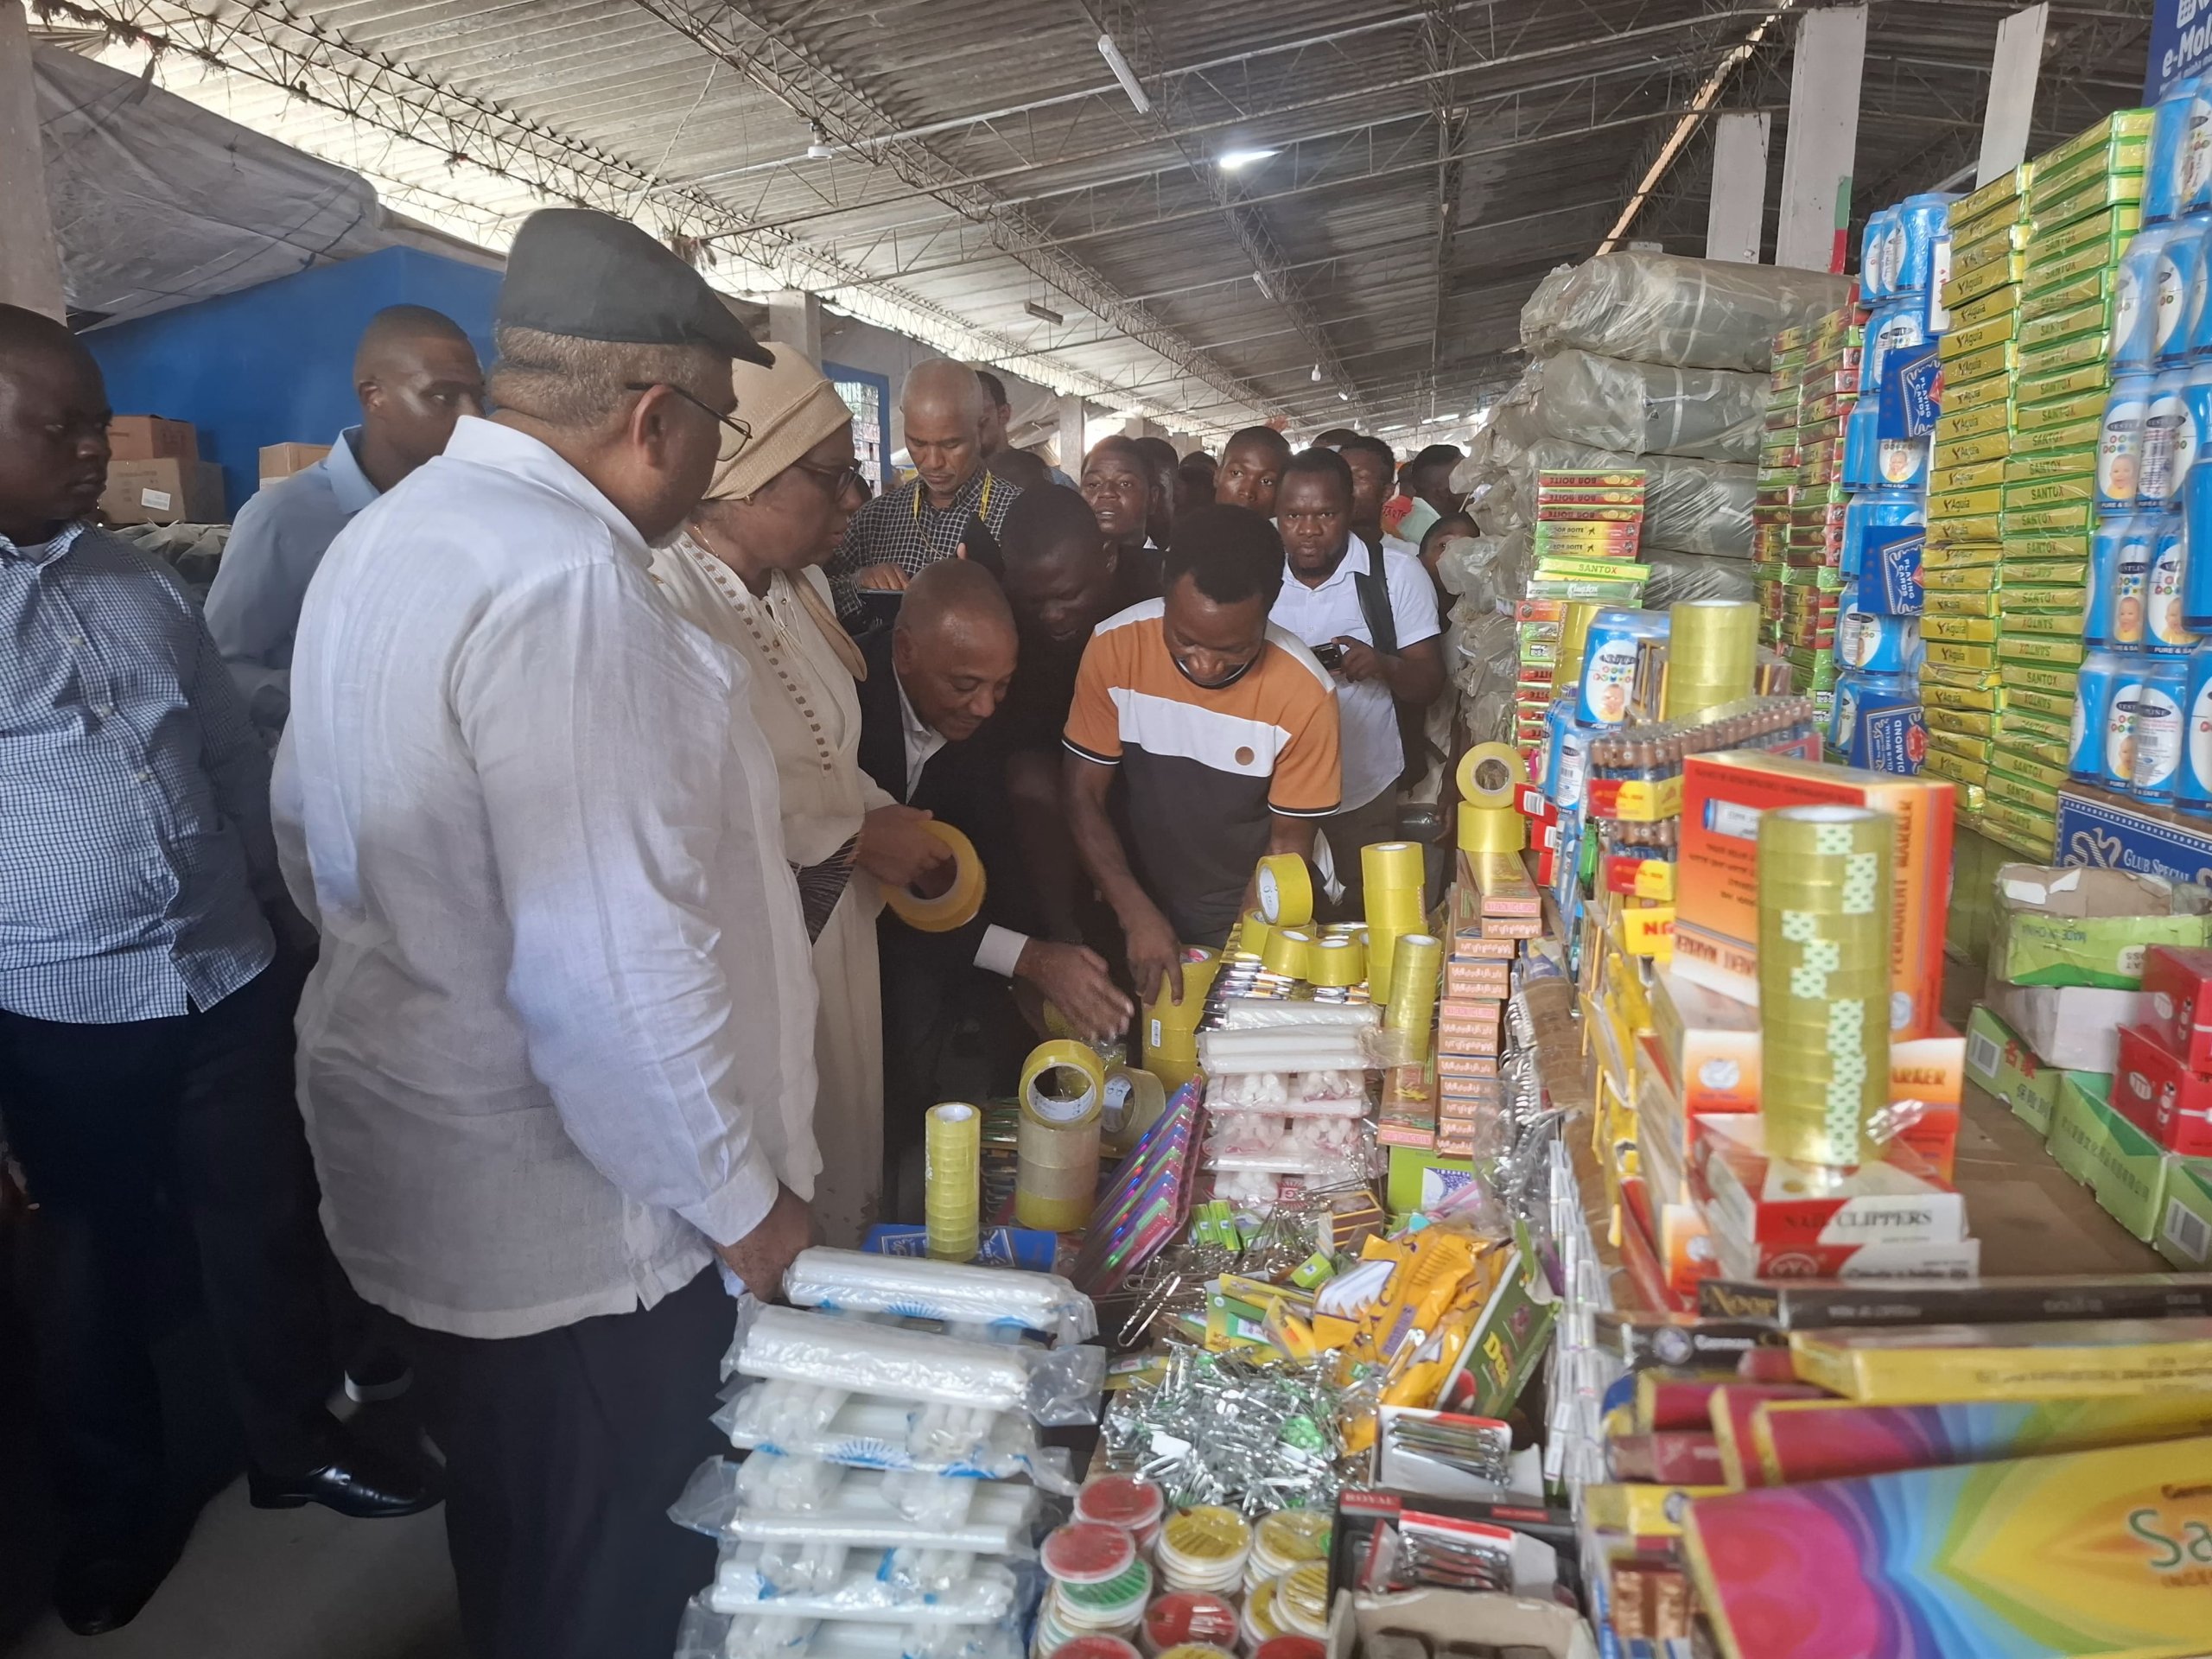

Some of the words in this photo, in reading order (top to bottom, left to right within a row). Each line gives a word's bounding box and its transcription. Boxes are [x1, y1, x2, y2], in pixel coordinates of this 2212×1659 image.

[1916, 384, 1925, 416] CARDS
[1920, 376, 1931, 418] PLAYING
[2031, 485, 2064, 500] SANTOX
[1579, 563, 1618, 575] SANTOX
[1898, 565, 1908, 596] CARDS
[1904, 559, 1915, 599] PLAYING
[2027, 671, 2057, 687] SANTOX
[1894, 720, 1905, 772] DIAMOND
[1837, 1211, 1932, 1227] CLIPPERS
